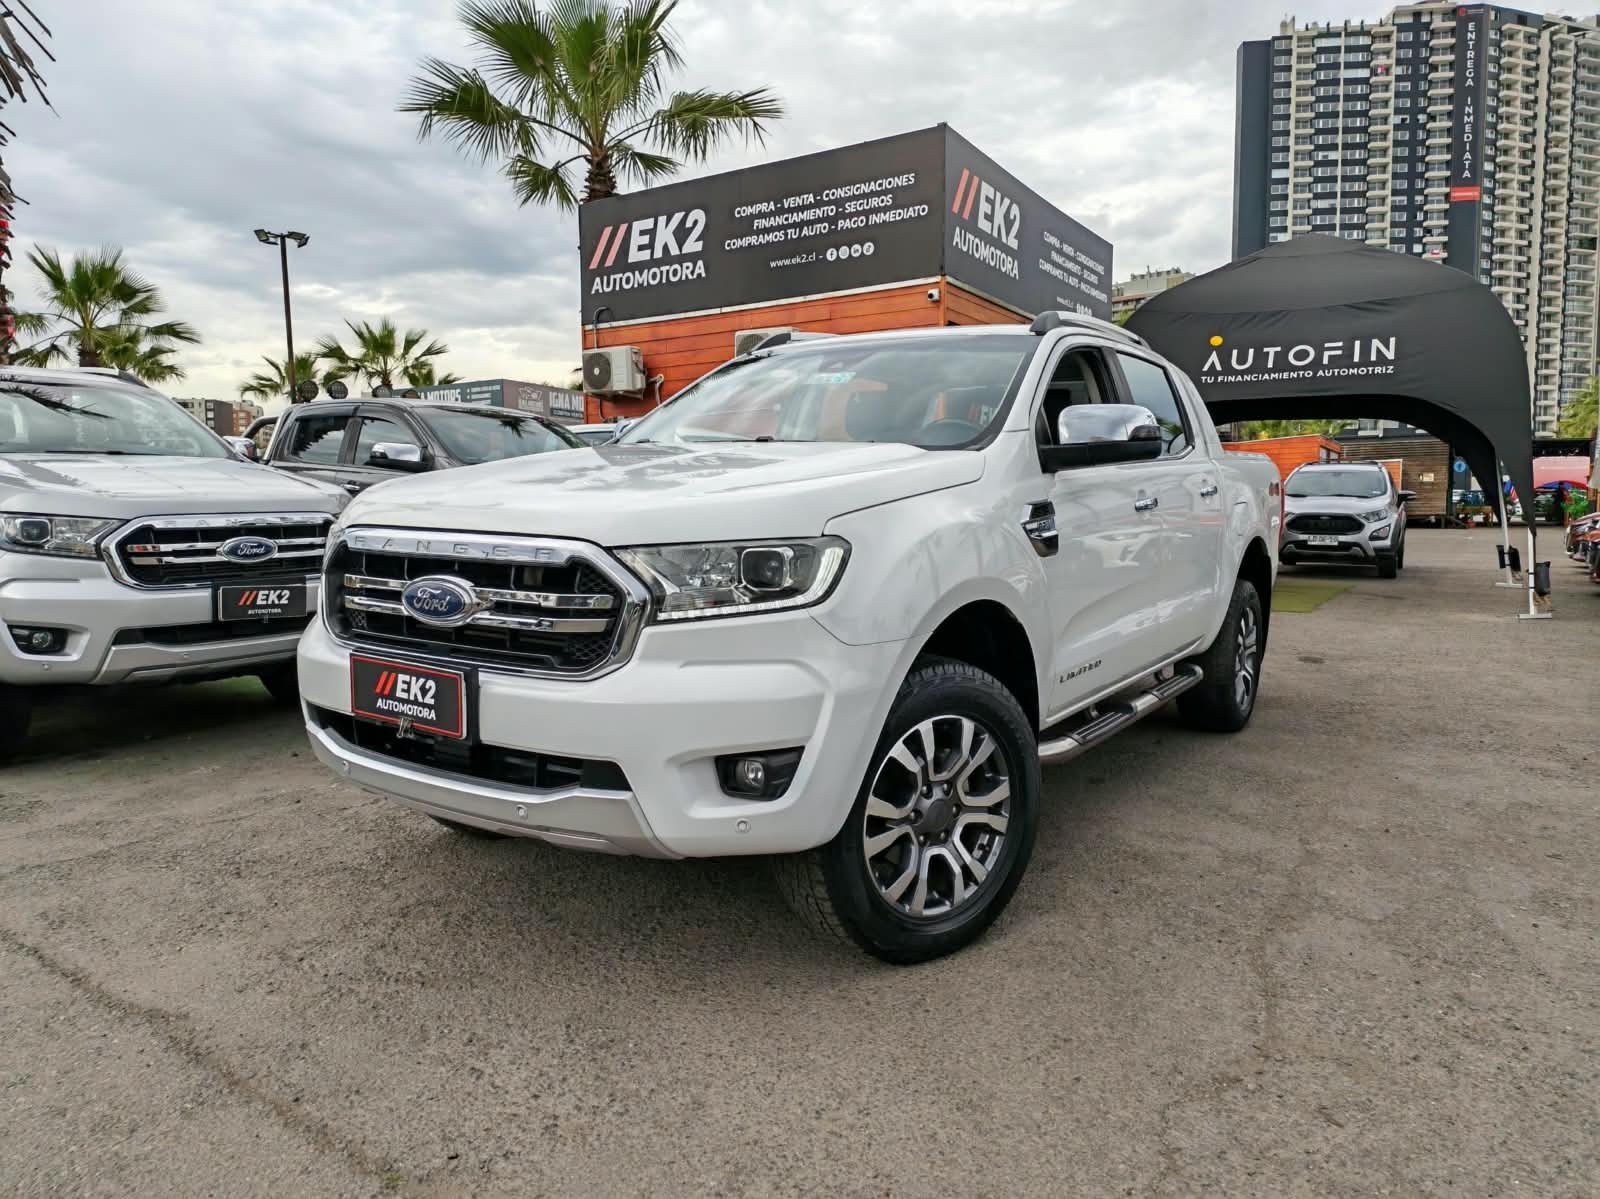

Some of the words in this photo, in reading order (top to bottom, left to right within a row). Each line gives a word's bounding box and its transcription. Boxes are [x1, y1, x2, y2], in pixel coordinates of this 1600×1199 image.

[1464, 22, 1476, 87] ENTREGA
[1462, 96, 1474, 178] INMEDIATA
[734, 200, 775, 218] COMPRA
[783, 193, 814, 209] VENTA
[822, 173, 916, 201] CONSIGNACIONES
[753, 204, 836, 230] FINANCIAMIENTO
[844, 194, 893, 214] SEGUROS
[724, 230, 785, 250] COMPRAMOS
[786, 228, 799, 240] TU
[801, 222, 829, 238] AUTO
[838, 216, 866, 231] PAGO
[868, 204, 928, 226] INMEDIATO
[770, 252, 816, 268] www.ek2.cl
[953, 226, 1019, 280] AUTOMOTORA
[590, 260, 706, 294] AUTOMOTORA
[1202, 336, 1396, 372] AUTOFIN
[1218, 370, 1313, 383] FINANCIAMIENTO
[1316, 366, 1395, 377] AUTOMOTRIZ
[237, 543, 266, 555] Ford
[354, 535, 555, 560] RANGER
[414, 587, 449, 612] Ford
[376, 698, 436, 720] AUTOMOTORA
